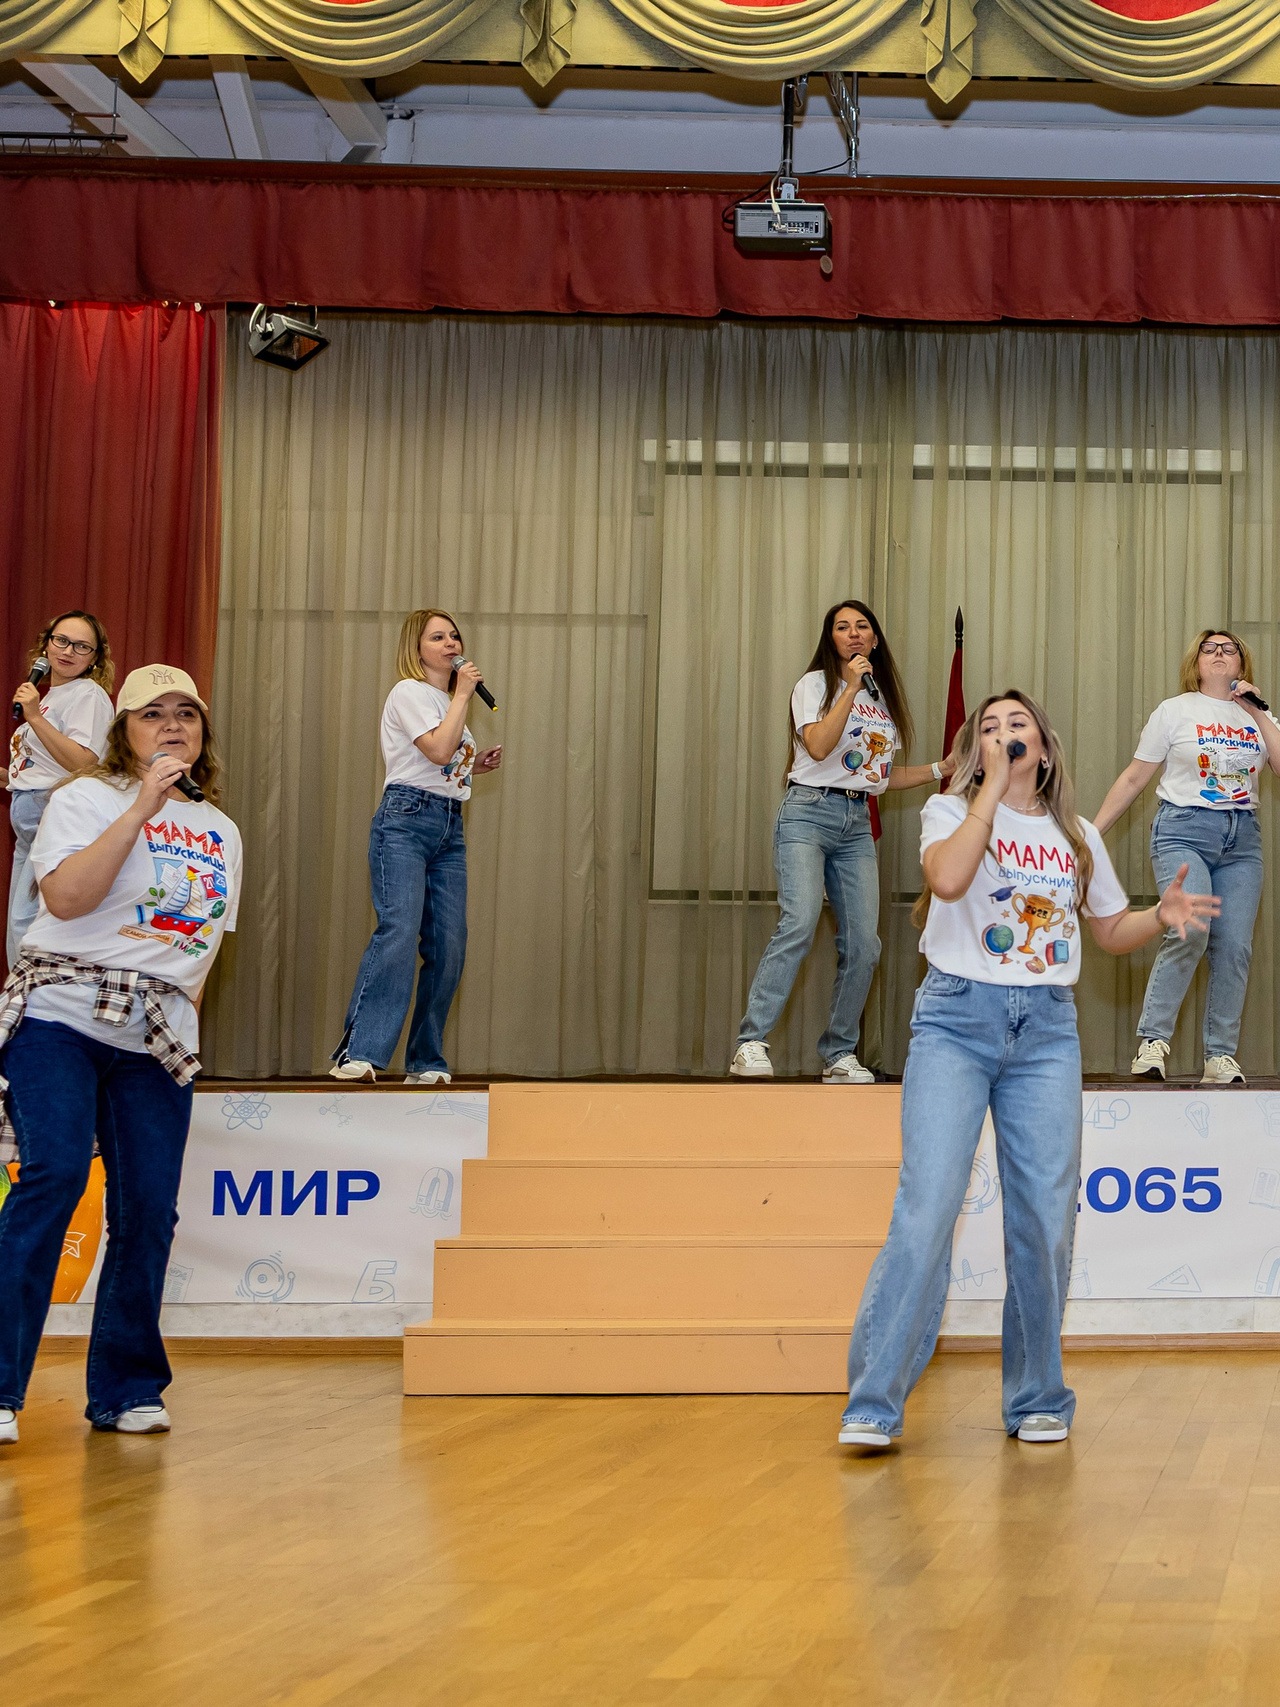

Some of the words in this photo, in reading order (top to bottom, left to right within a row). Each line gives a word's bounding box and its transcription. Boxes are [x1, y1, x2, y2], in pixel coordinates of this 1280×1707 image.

[1196, 723, 1259, 743] МАМА
[143, 820, 224, 860] МАМА
[997, 838, 1076, 876] МАМА
[1026, 904, 1048, 919] 2025
[212, 1170, 381, 1216] МИР
[1077, 1166, 1222, 1213] 065
